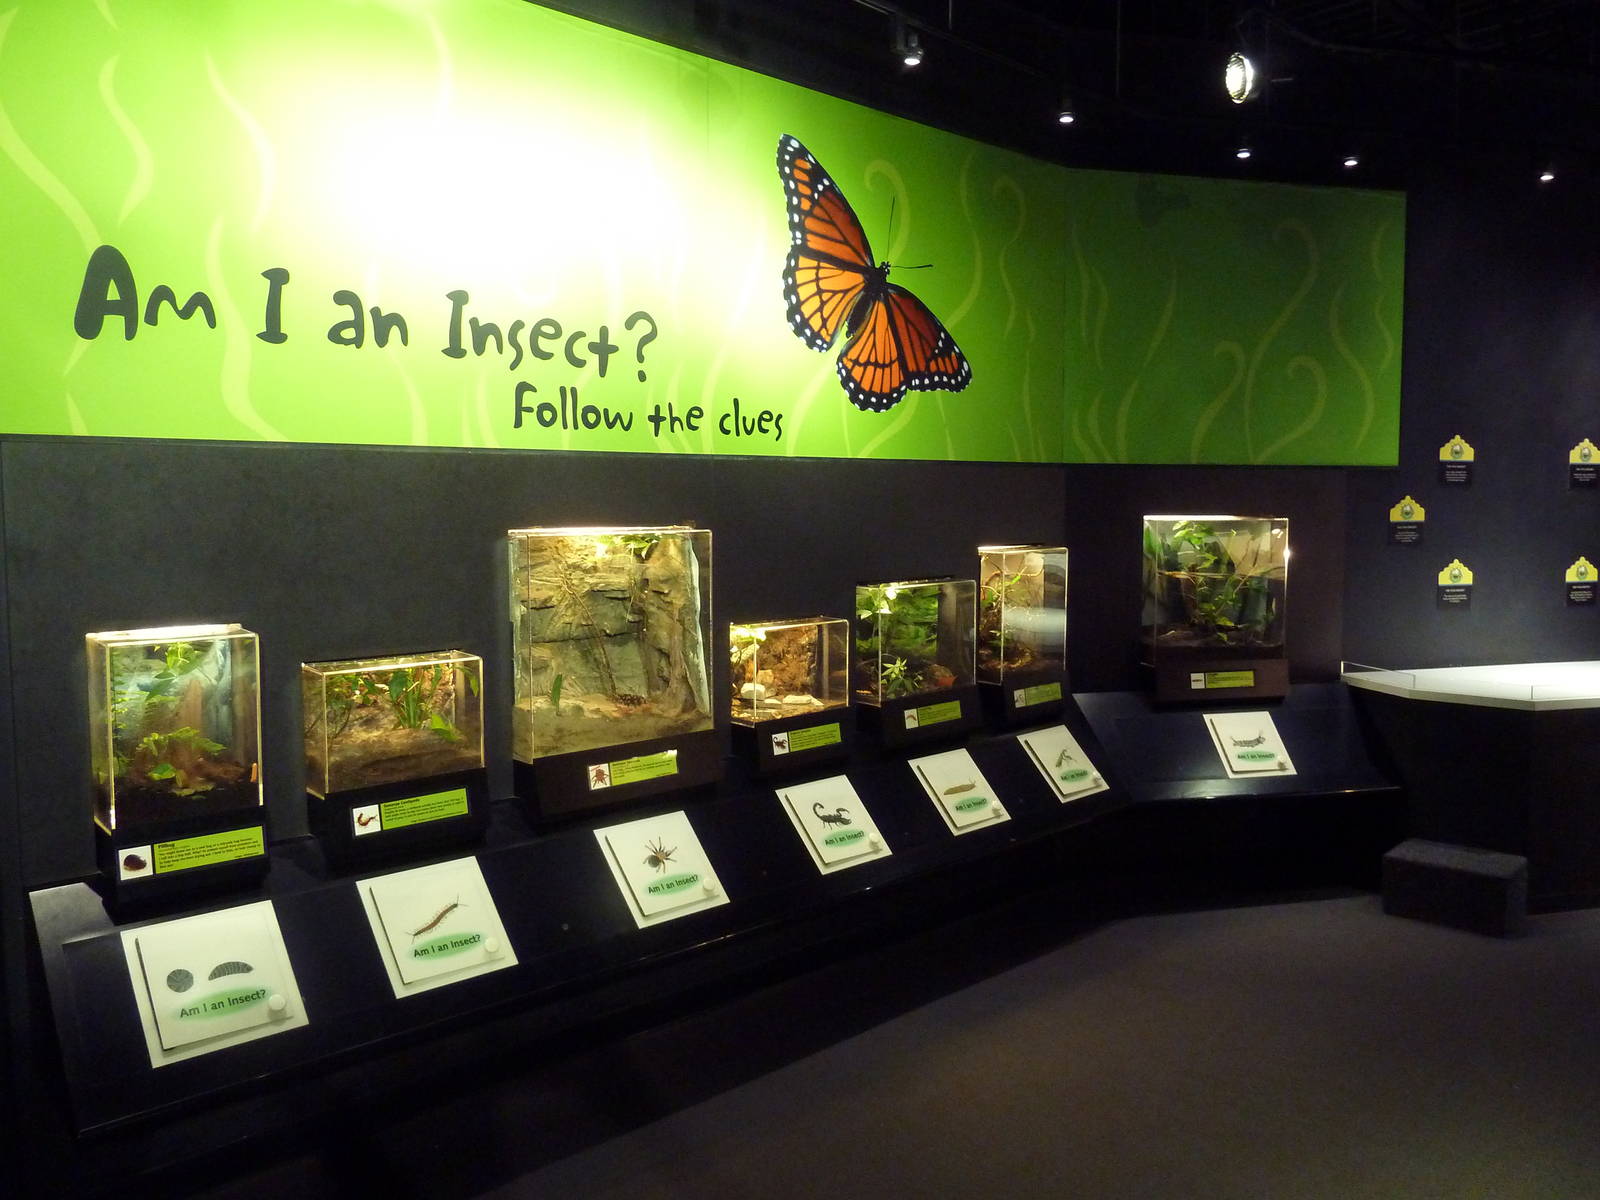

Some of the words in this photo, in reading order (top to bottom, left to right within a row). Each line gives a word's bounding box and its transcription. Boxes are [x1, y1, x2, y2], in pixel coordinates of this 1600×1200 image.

[74, 245, 216, 341] Am
[256, 267, 290, 344] I
[327, 289, 409, 349] an
[441, 289, 658, 383] Insect?
[513, 381, 634, 432] Follow
[647, 402, 704, 437] the
[719, 397, 783, 443] clues
[648, 886, 660, 894] Am
[676, 874, 698, 887] Insect?
[414, 948, 429, 958] Am
[438, 944, 449, 952] an
[450, 934, 481, 949] Insect?
[180, 1006, 200, 1018] Am
[203, 1003, 208, 1012] I
[211, 1000, 225, 1010] an
[228, 989, 267, 1006] Insect?
